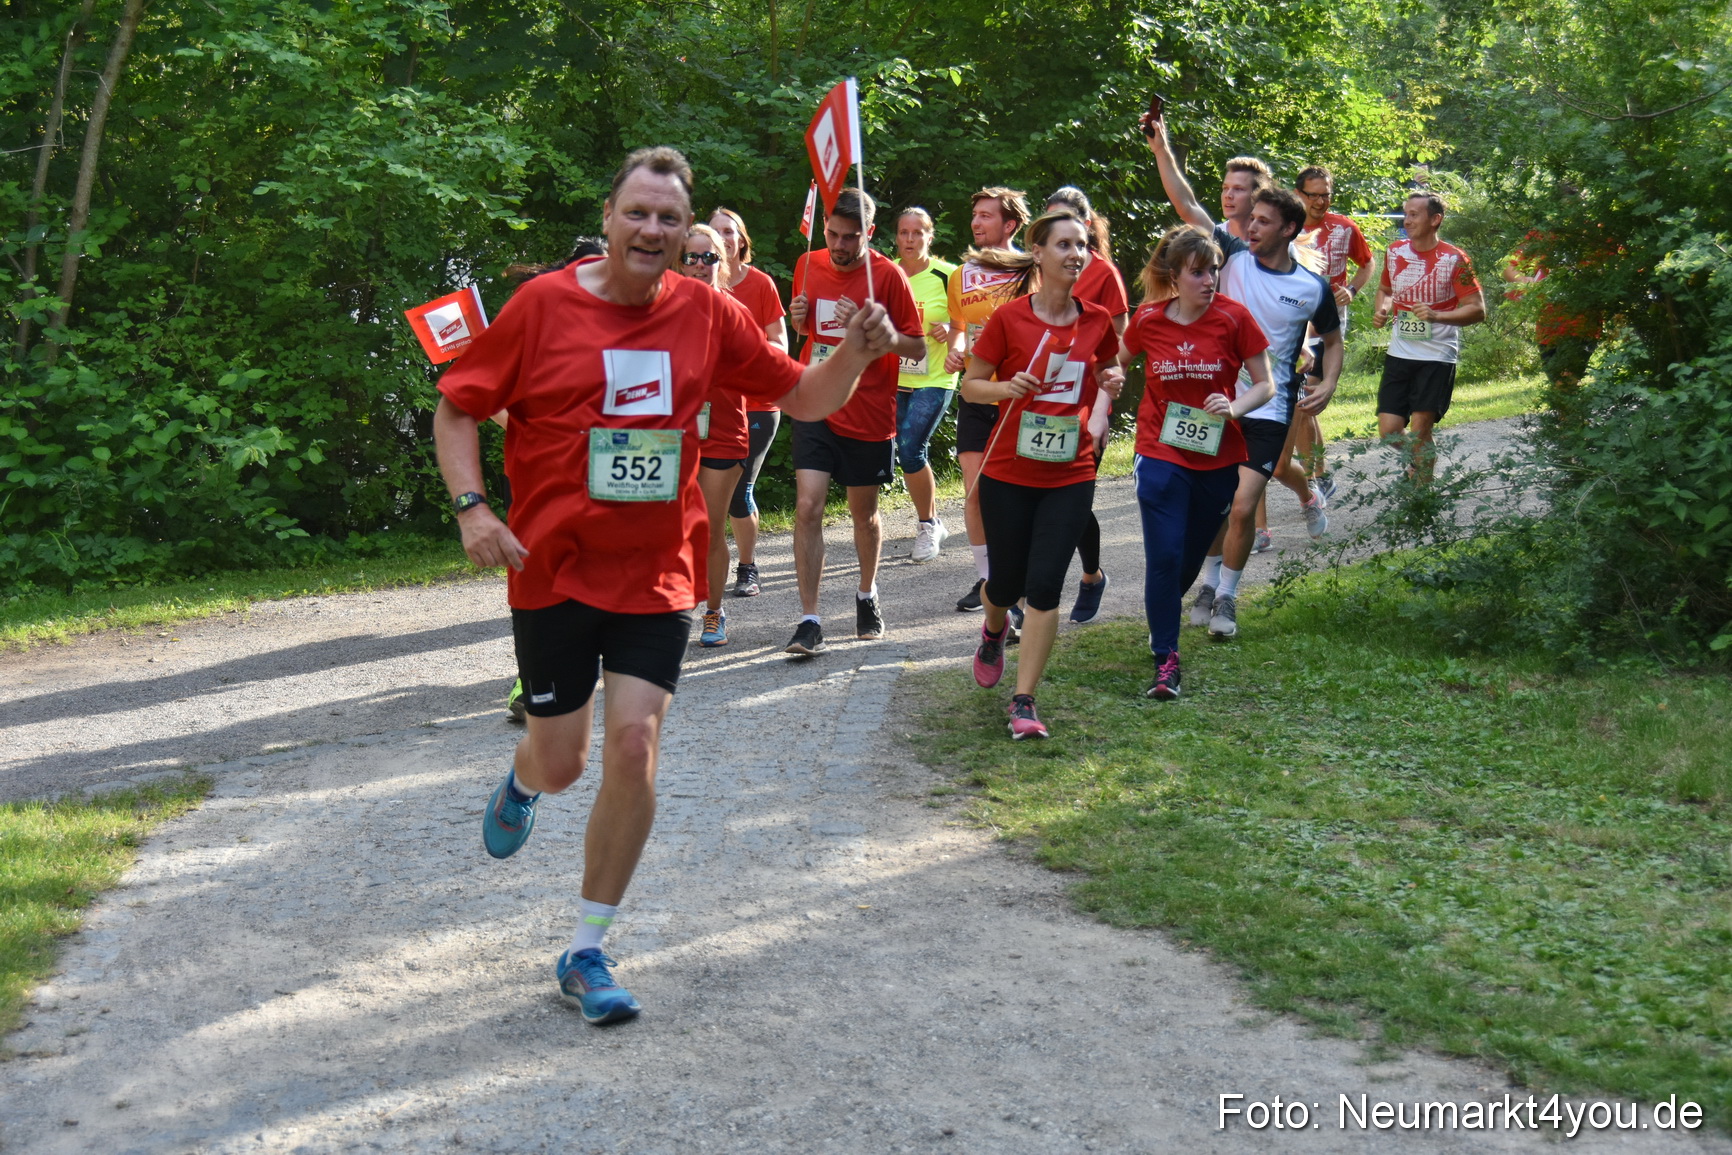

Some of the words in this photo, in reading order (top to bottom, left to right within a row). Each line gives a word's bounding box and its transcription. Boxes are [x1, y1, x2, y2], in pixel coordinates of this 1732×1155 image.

[961, 292, 988, 307] MAX
[1279, 295, 1299, 306] swn
[1399, 320, 1426, 333] 2233
[1152, 360, 1178, 374] Echtes
[1178, 359, 1222, 373] Handwerk
[626, 387, 648, 400] DEHN
[1175, 421, 1209, 441] 595
[1031, 431, 1065, 449] 471
[611, 455, 662, 481] 552
